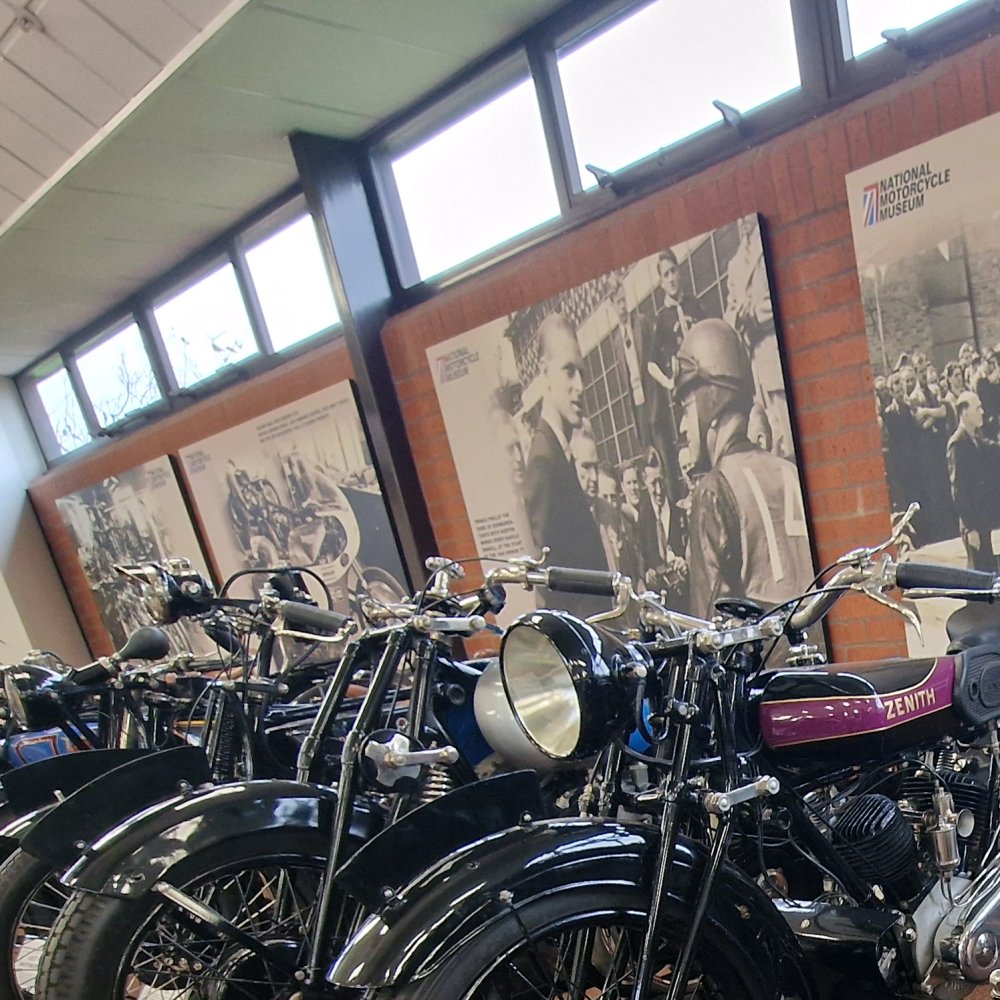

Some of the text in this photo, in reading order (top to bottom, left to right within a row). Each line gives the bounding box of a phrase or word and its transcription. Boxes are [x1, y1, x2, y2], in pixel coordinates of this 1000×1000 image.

[880, 162, 932, 193] NATIONAL
[880, 168, 951, 207] MOTORCYCLE
[880, 194, 925, 221] MUSEUM
[884, 688, 936, 721] ZENITH
